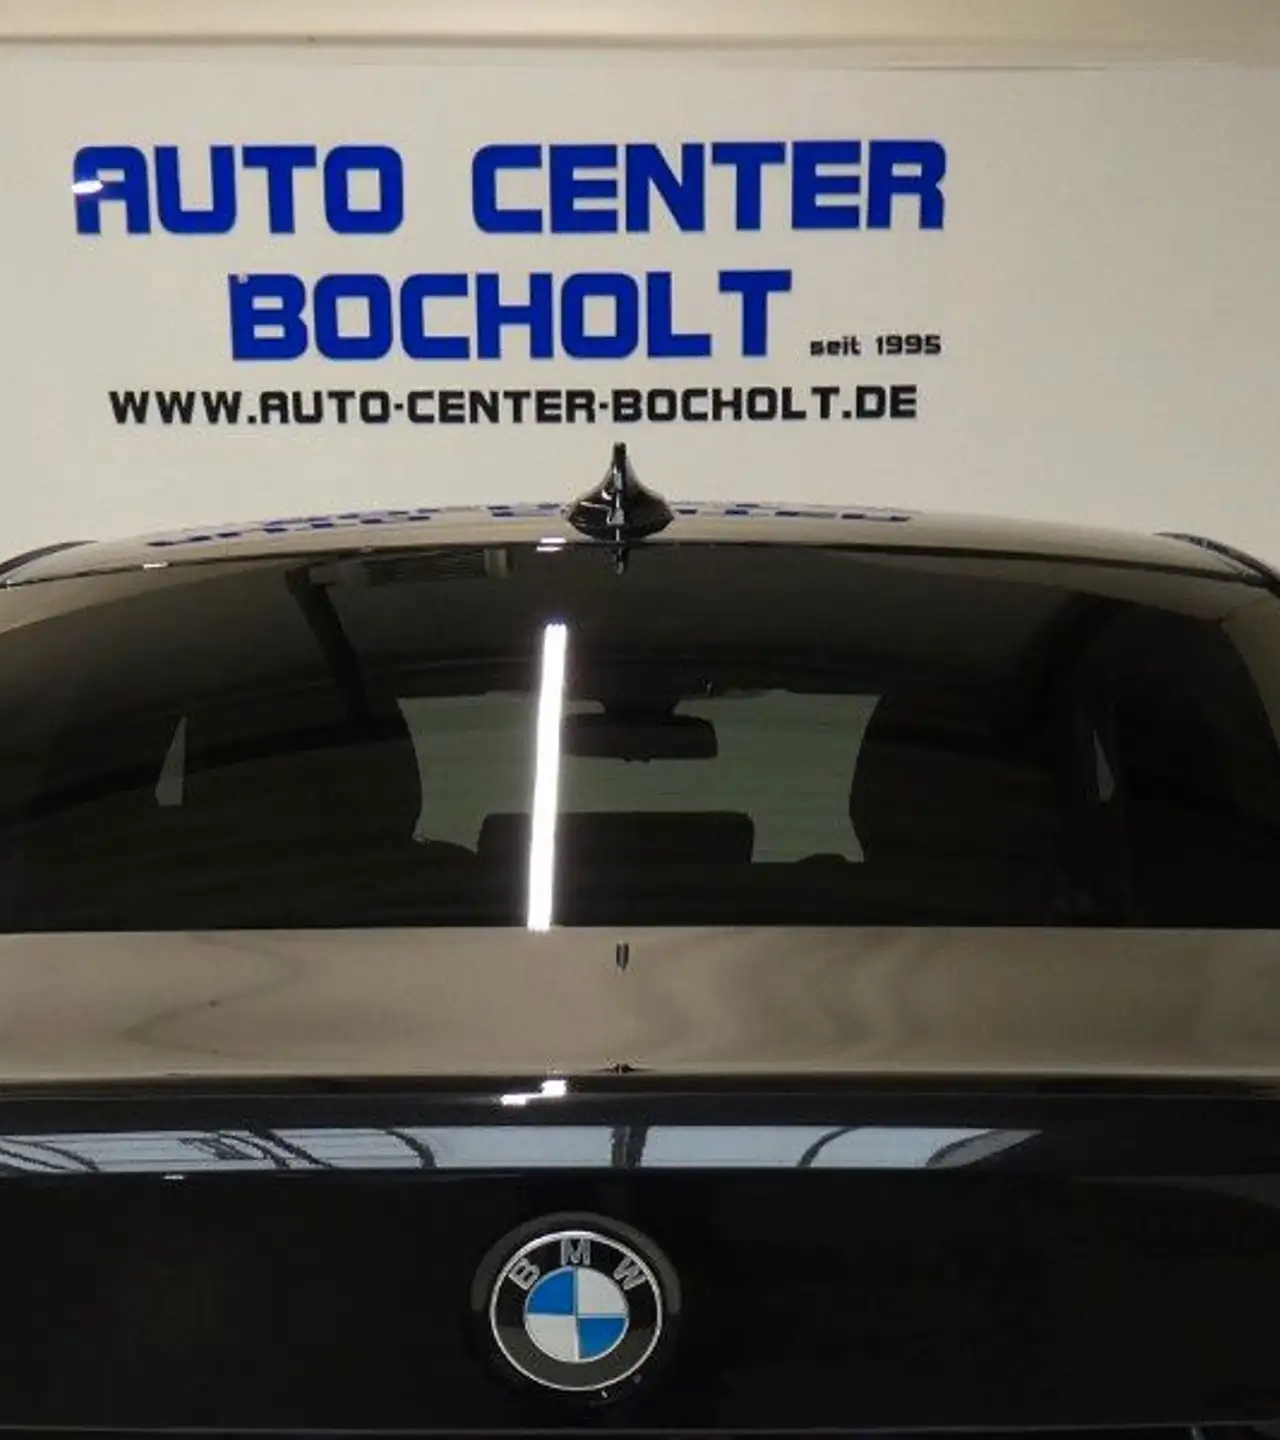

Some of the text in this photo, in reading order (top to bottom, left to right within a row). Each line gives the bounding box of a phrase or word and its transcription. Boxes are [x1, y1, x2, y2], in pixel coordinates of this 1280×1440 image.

[72, 139, 948, 236] AUTO CENTER
[228, 268, 793, 362] BOCHOLT
[809, 332, 943, 357] seit 1995
[107, 384, 918, 426] WWW.AUTO-CENTER-BOCHOLT.DE
[507, 1237, 648, 1291] BMW
